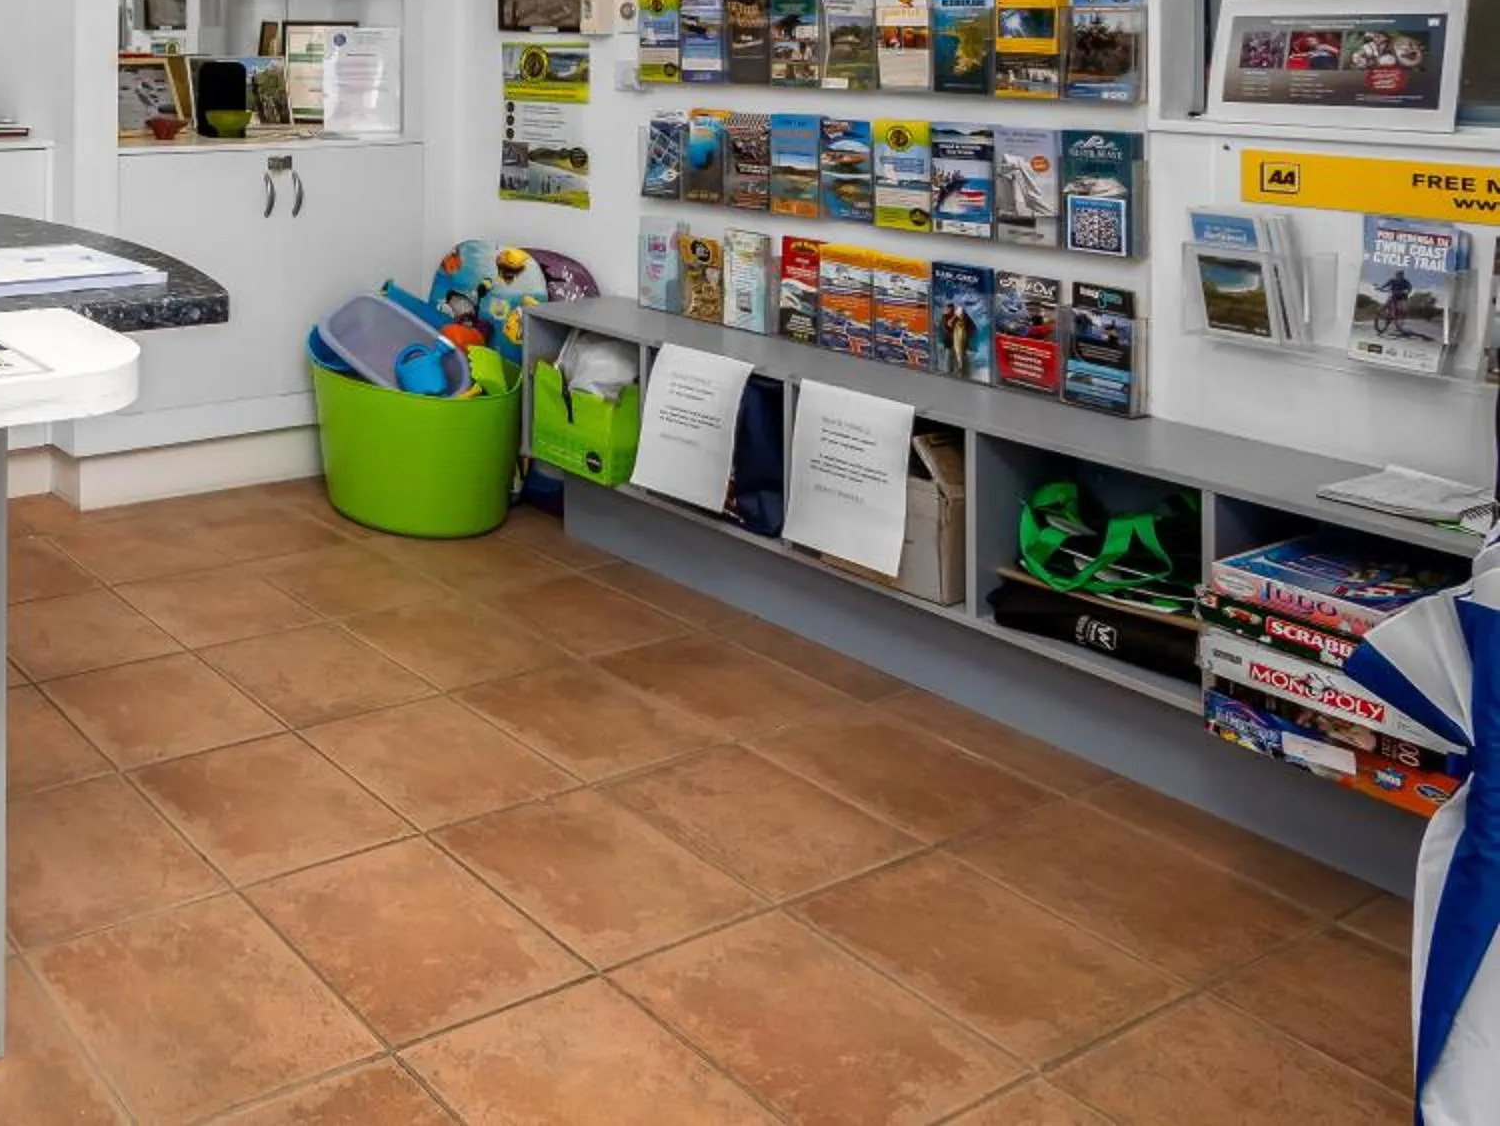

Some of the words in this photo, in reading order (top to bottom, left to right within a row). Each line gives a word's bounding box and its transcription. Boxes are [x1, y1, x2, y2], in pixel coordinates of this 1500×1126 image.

[1268, 170, 1296, 186] AA
[1412, 173, 1476, 193] FREE
[1373, 239, 1406, 254] TWIN
[1409, 245, 1448, 260] COAST
[1373, 251, 1412, 267] CYCLE
[1413, 258, 1447, 272] TRAIL
[1250, 664, 1385, 723] MONOPOLY
